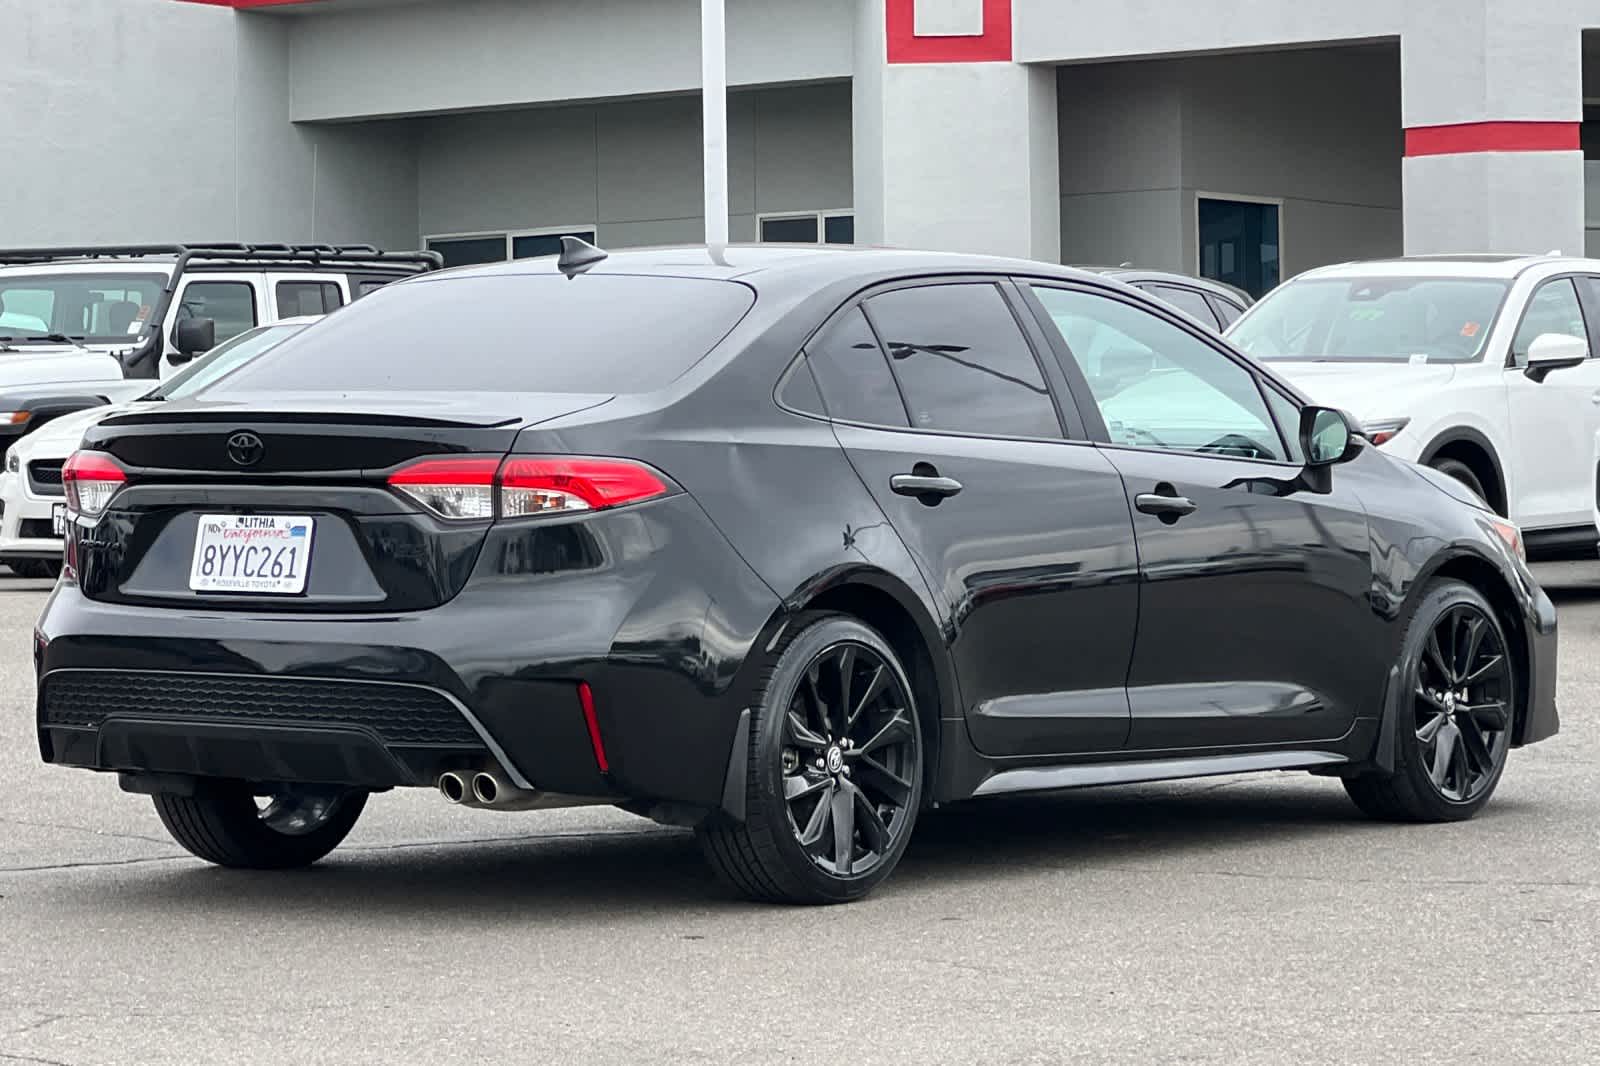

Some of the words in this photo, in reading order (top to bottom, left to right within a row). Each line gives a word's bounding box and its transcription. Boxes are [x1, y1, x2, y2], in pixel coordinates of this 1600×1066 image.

[245, 518, 275, 528] LITHIA
[223, 528, 289, 544] California
[202, 545, 297, 578] 8YYC261
[252, 581, 276, 589] TOYOTA
